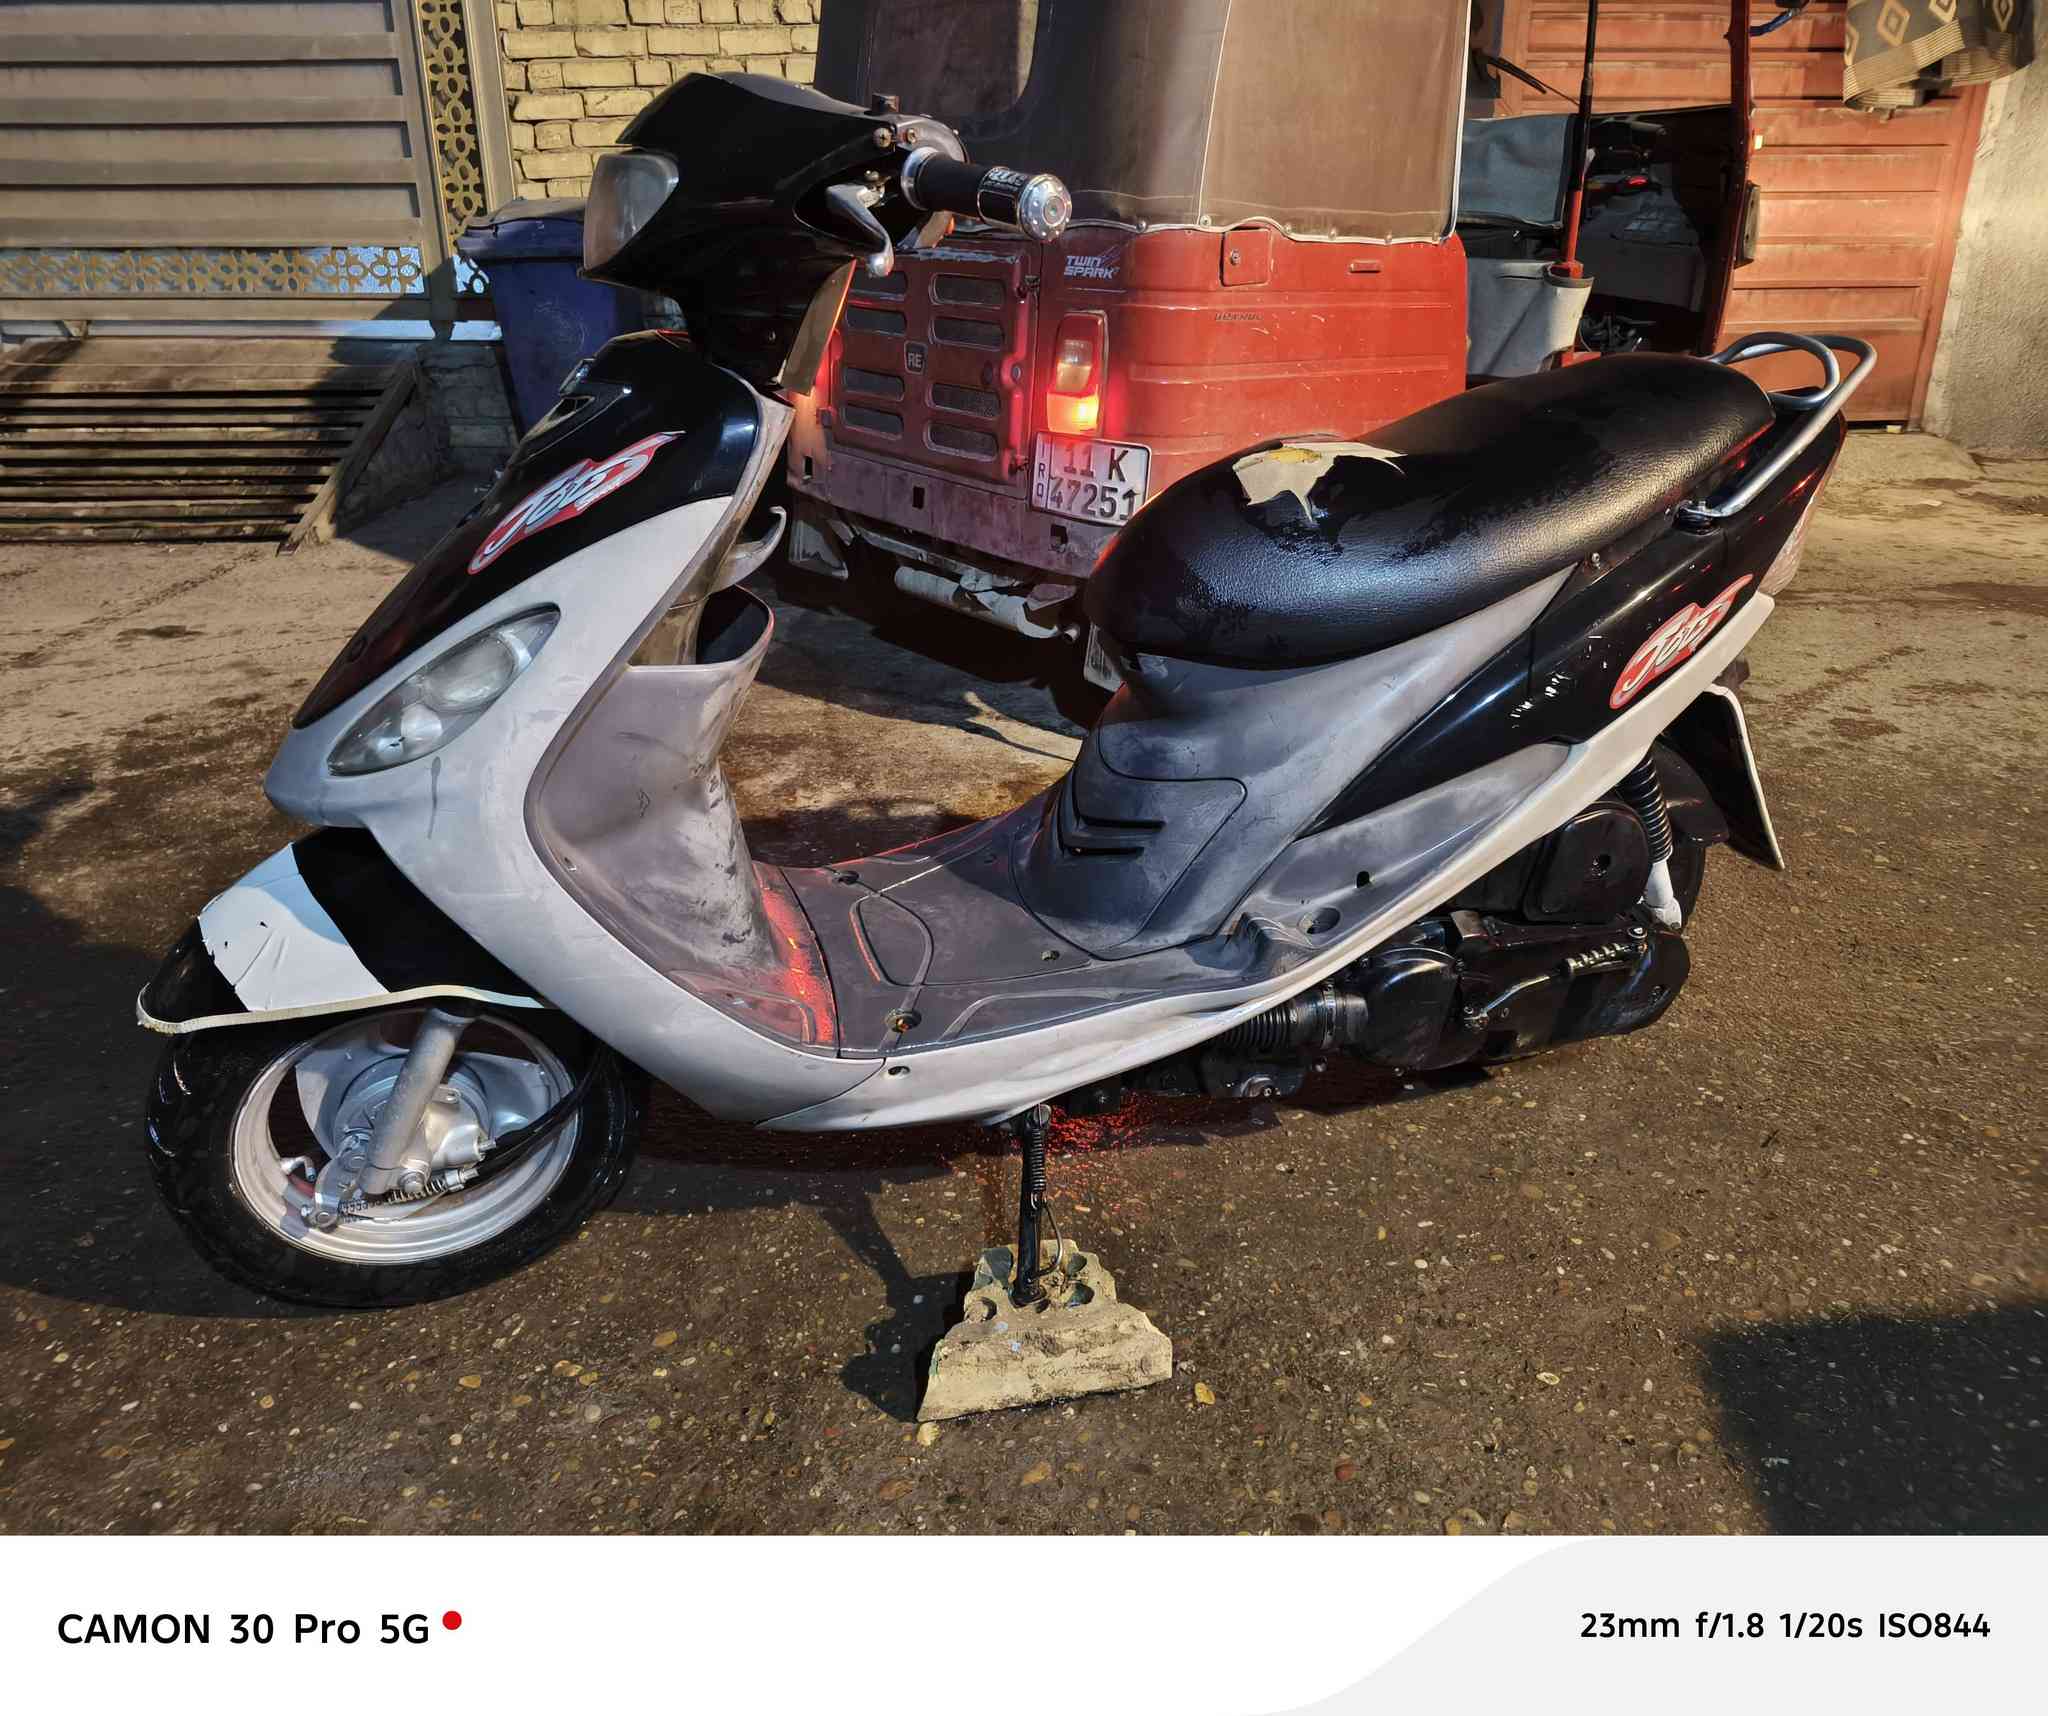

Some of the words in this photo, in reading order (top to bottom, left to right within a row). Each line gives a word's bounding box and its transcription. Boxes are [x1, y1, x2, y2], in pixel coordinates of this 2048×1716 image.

[1066, 255, 1102, 267] TWIN
[1063, 265, 1115, 279] SPARK
[907, 352, 922, 368] RE
[1063, 442, 1094, 479] 11
[1107, 447, 1129, 482] K
[1048, 475, 1139, 520] 47251
